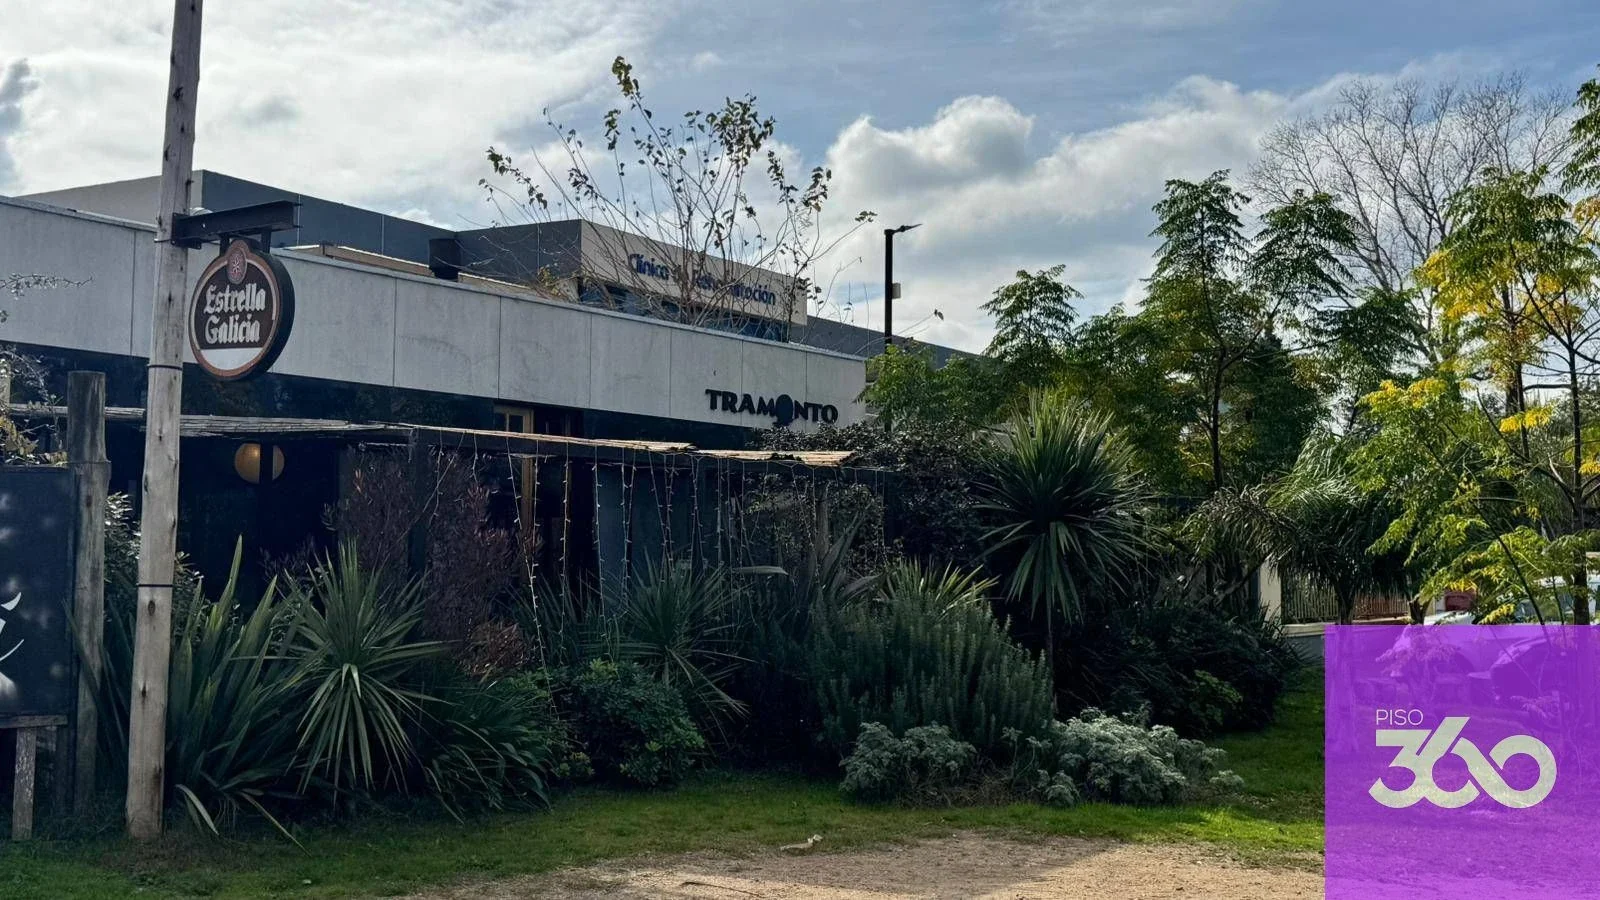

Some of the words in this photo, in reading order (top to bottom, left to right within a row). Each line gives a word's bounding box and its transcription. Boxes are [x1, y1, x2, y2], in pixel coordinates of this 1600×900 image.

[204, 283, 266, 314] Estrella
[205, 314, 260, 344] Galicia
[705, 388, 839, 426] TRAMONTO
